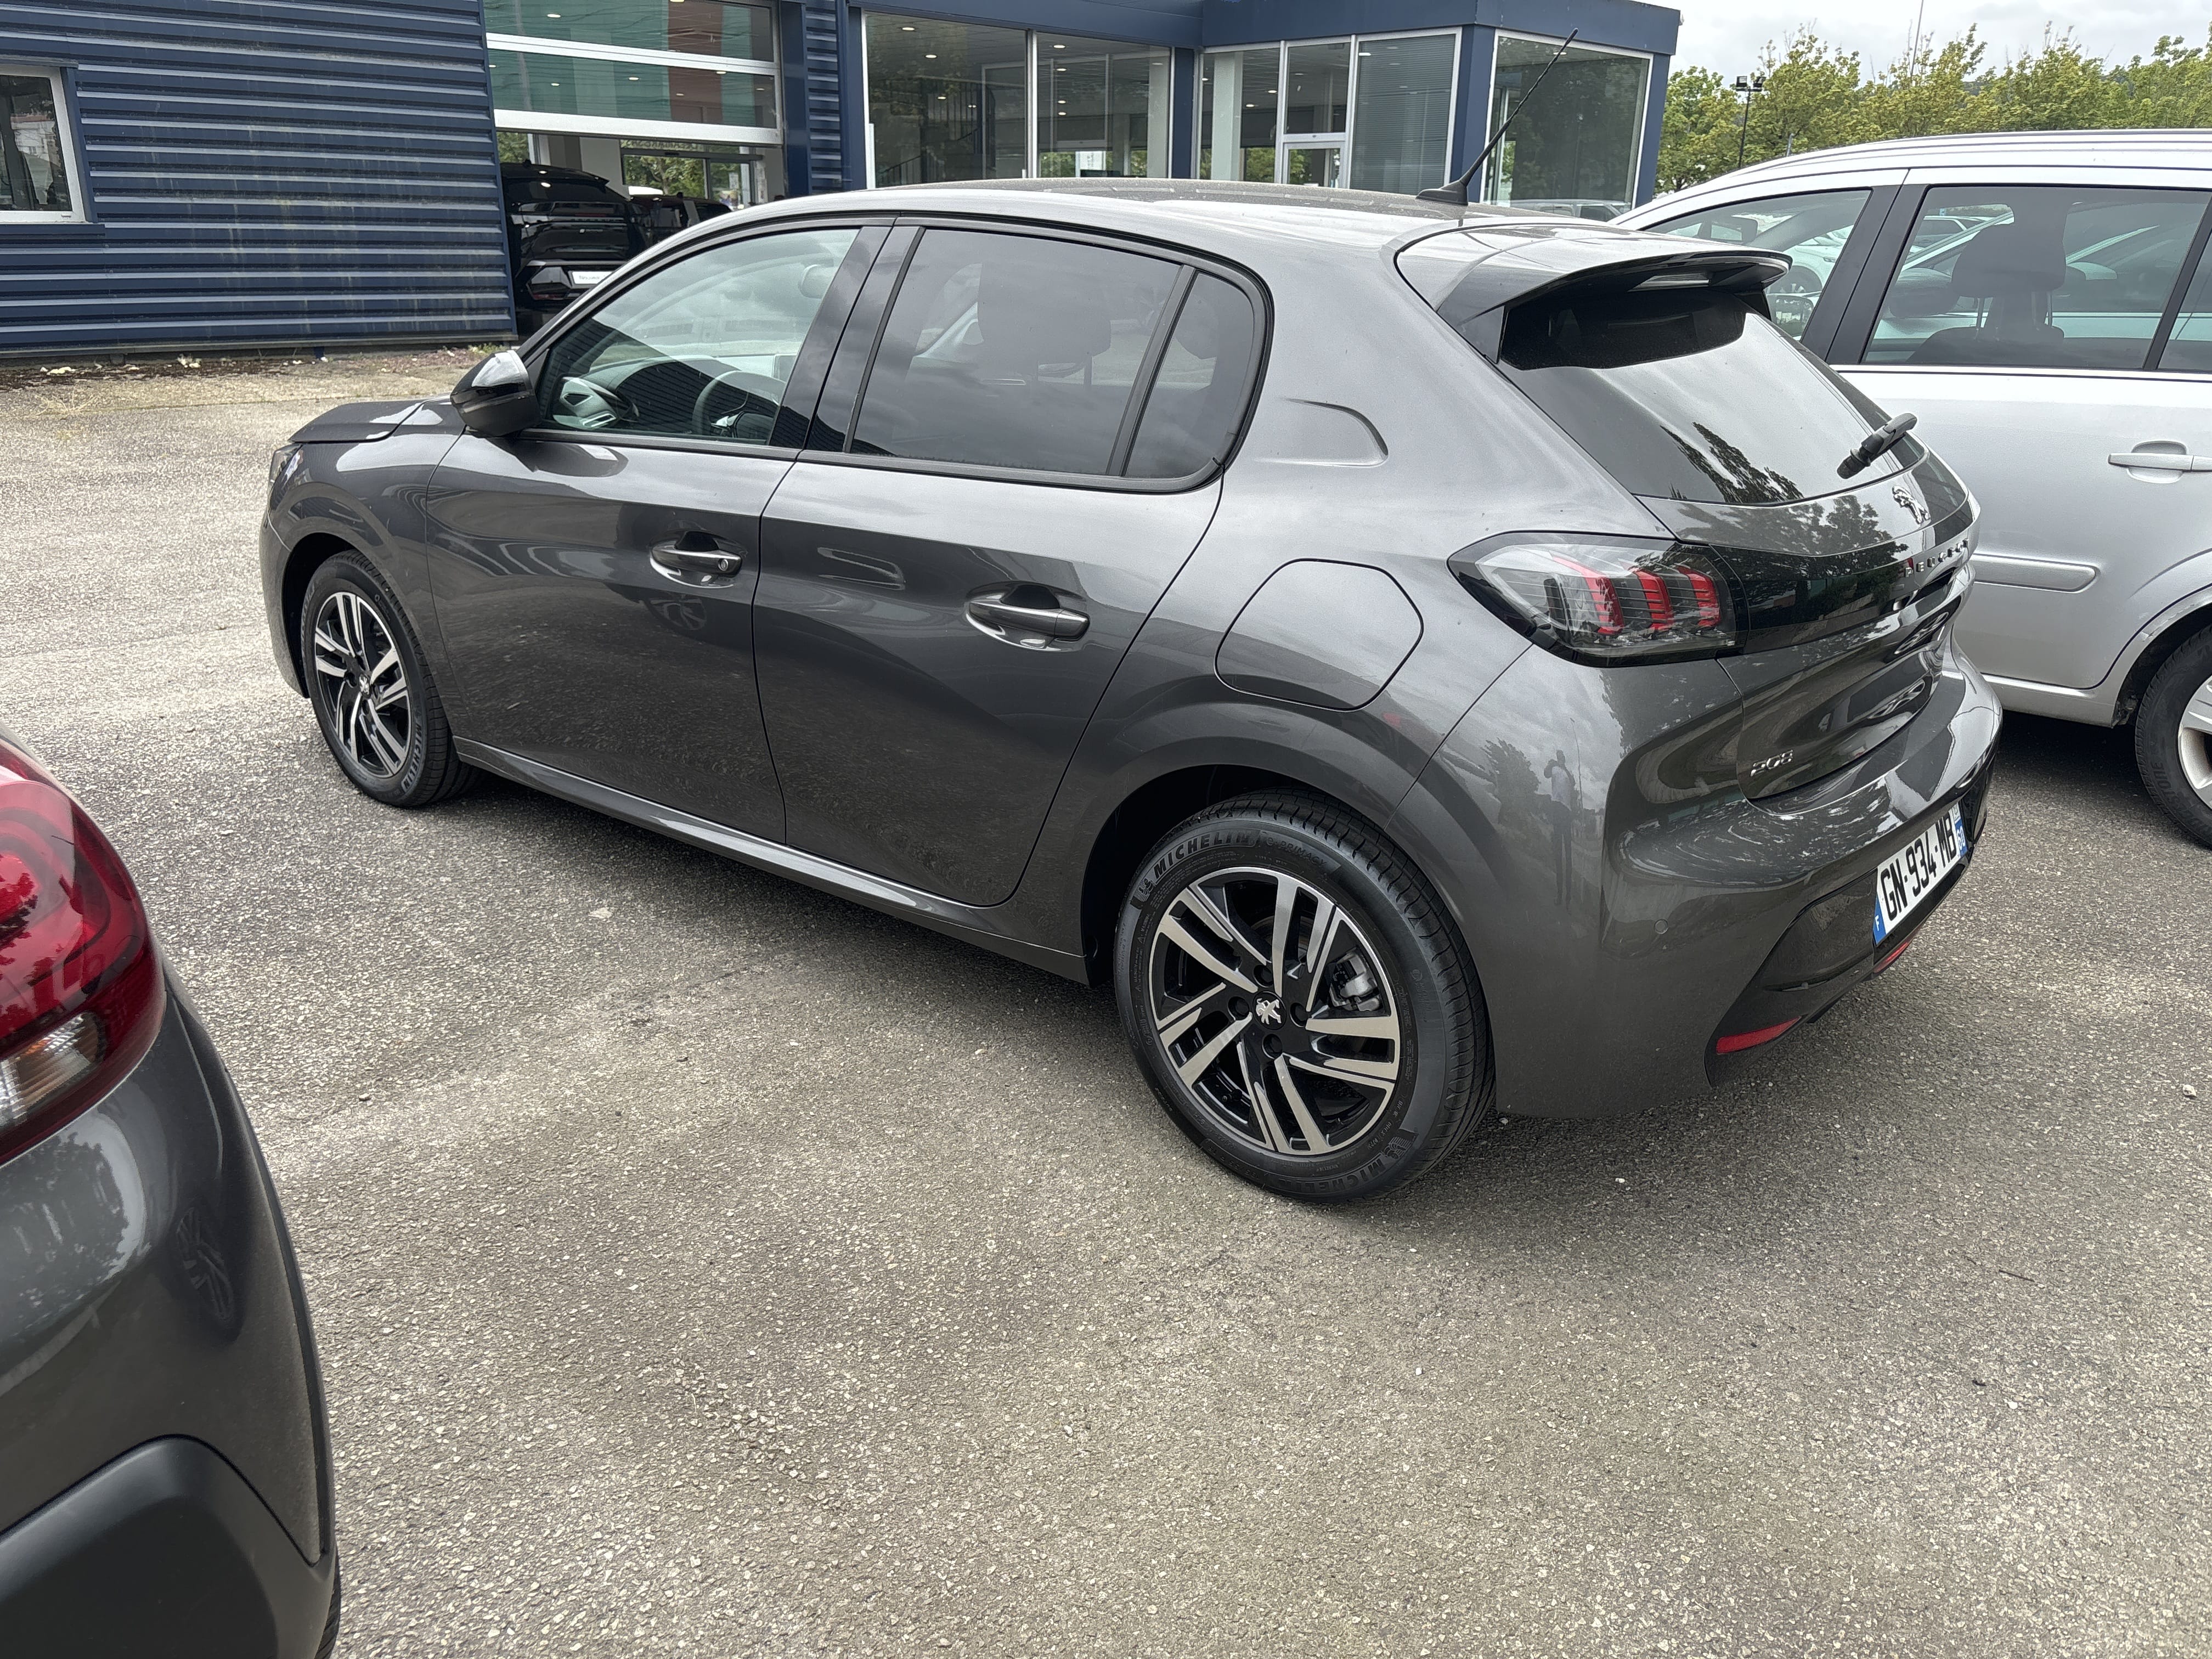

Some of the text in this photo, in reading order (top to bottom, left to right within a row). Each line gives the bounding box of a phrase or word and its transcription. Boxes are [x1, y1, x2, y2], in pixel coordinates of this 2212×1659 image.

[1904, 538, 1968, 578] PEUGEOT
[403, 724, 422, 790] MICHELIN
[1750, 749, 1793, 776] 208
[1154, 829, 1252, 879] MICHELIN
[1880, 812, 1957, 921] GN-934-MB
[1875, 915, 1880, 932] F
[1278, 1158, 1388, 1194] MICHELIN
